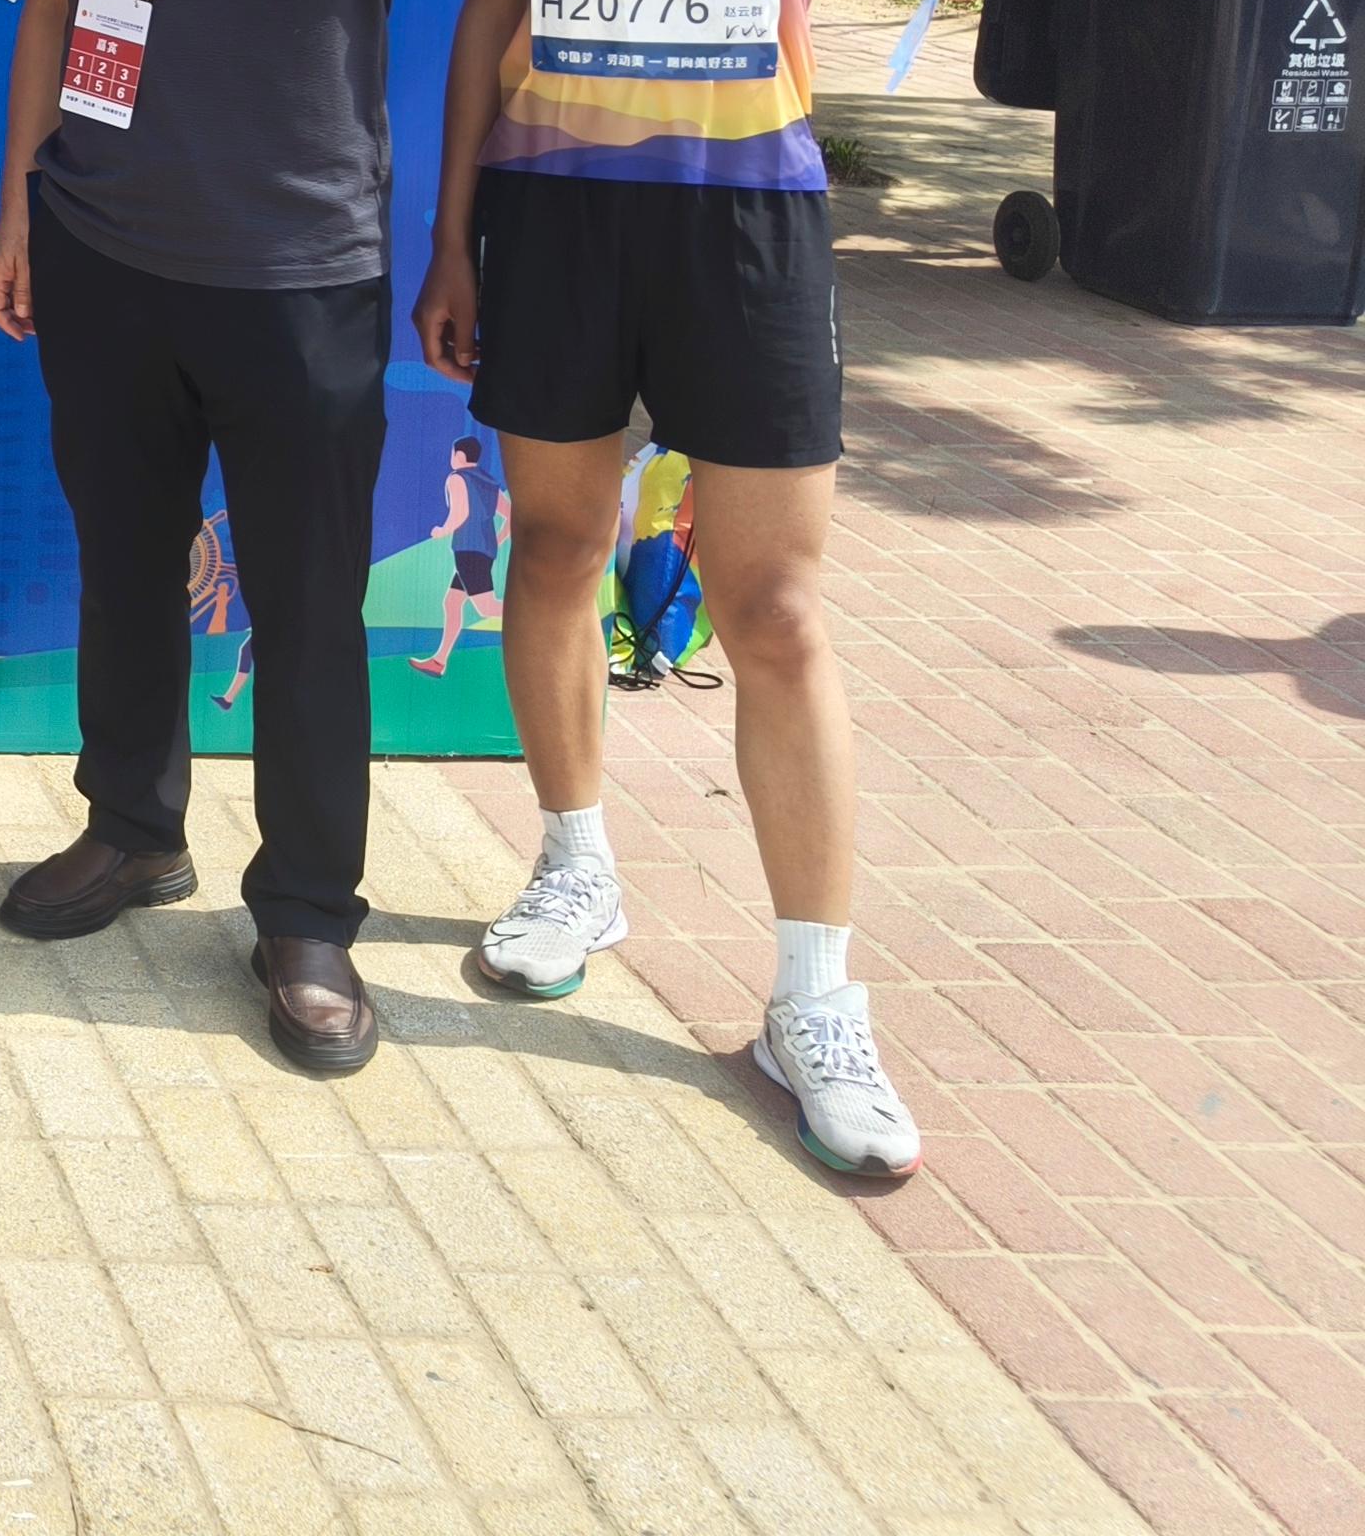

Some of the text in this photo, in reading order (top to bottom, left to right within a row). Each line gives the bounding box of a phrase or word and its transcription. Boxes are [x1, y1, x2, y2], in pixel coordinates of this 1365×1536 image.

[77, 55, 129, 81] 1 2 3
[1289, 52, 1346, 68] 其他垃圾
[1281, 68, 1350, 77] Residual Waste
[73, 73, 126, 99] 4 5 6
